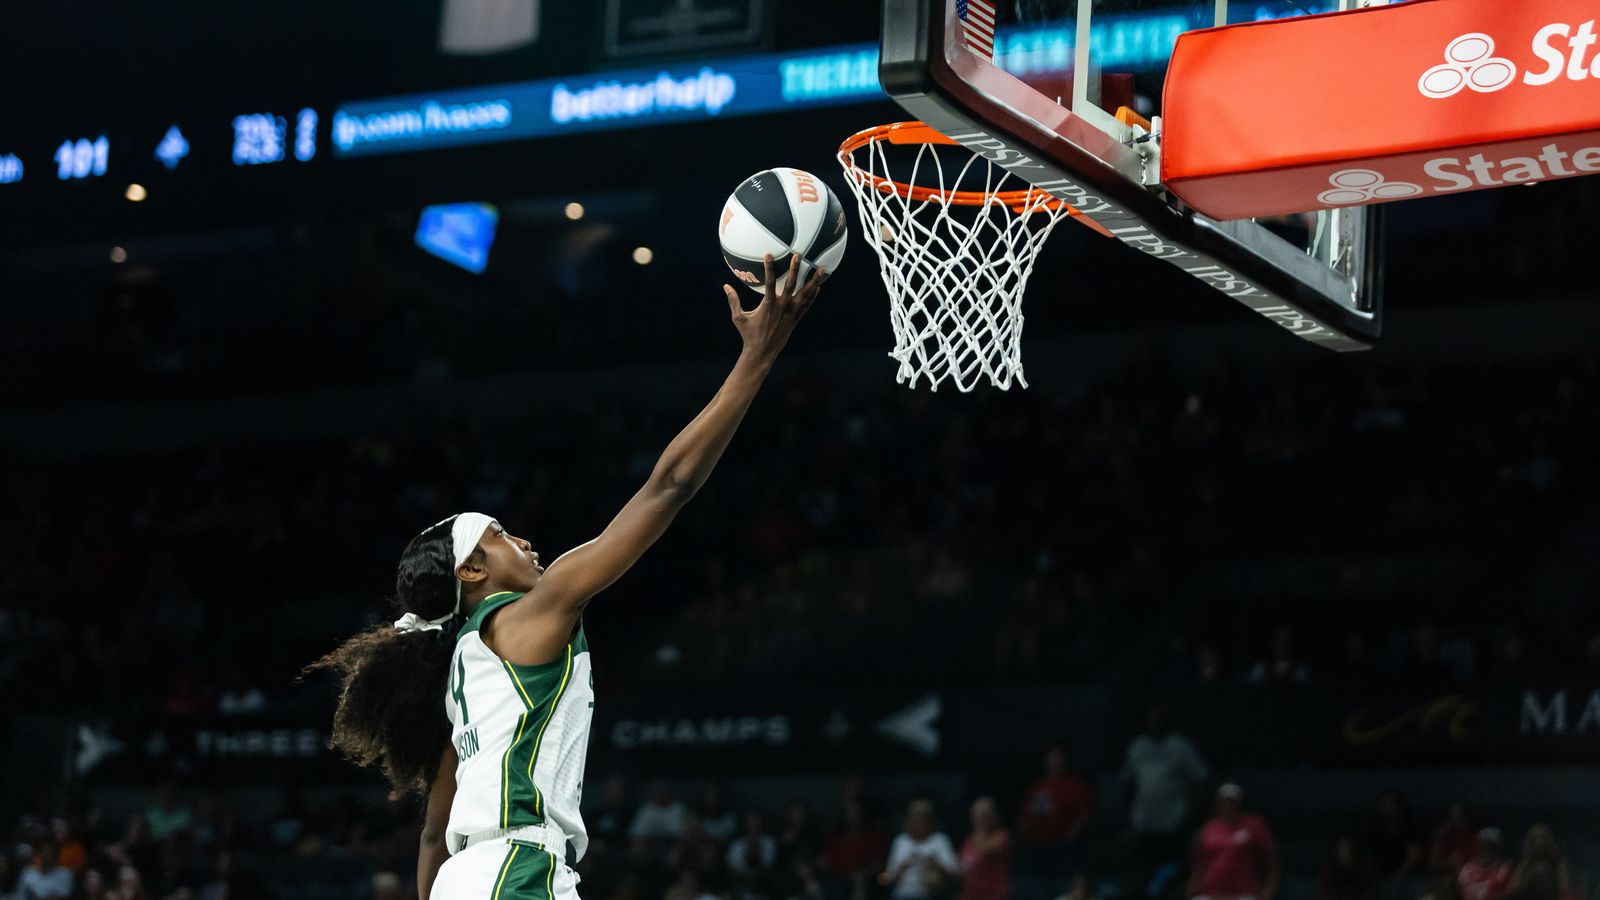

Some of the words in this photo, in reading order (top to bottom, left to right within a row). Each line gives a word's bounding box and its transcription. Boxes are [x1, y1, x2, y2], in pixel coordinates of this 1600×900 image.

[551, 67, 736, 124] betterhelp
[54, 134, 110, 181] 101
[1423, 143, 1600, 192] State
[947, 131, 1046, 168] IPSY
[1032, 178, 1124, 214] IPSY
[1109, 225, 1199, 259] IPSY
[1184, 264, 1268, 297] IPSY
[1254, 305, 1334, 336] IPSY
[458, 727, 480, 762] SON
[611, 715, 792, 748] CHAMPS
